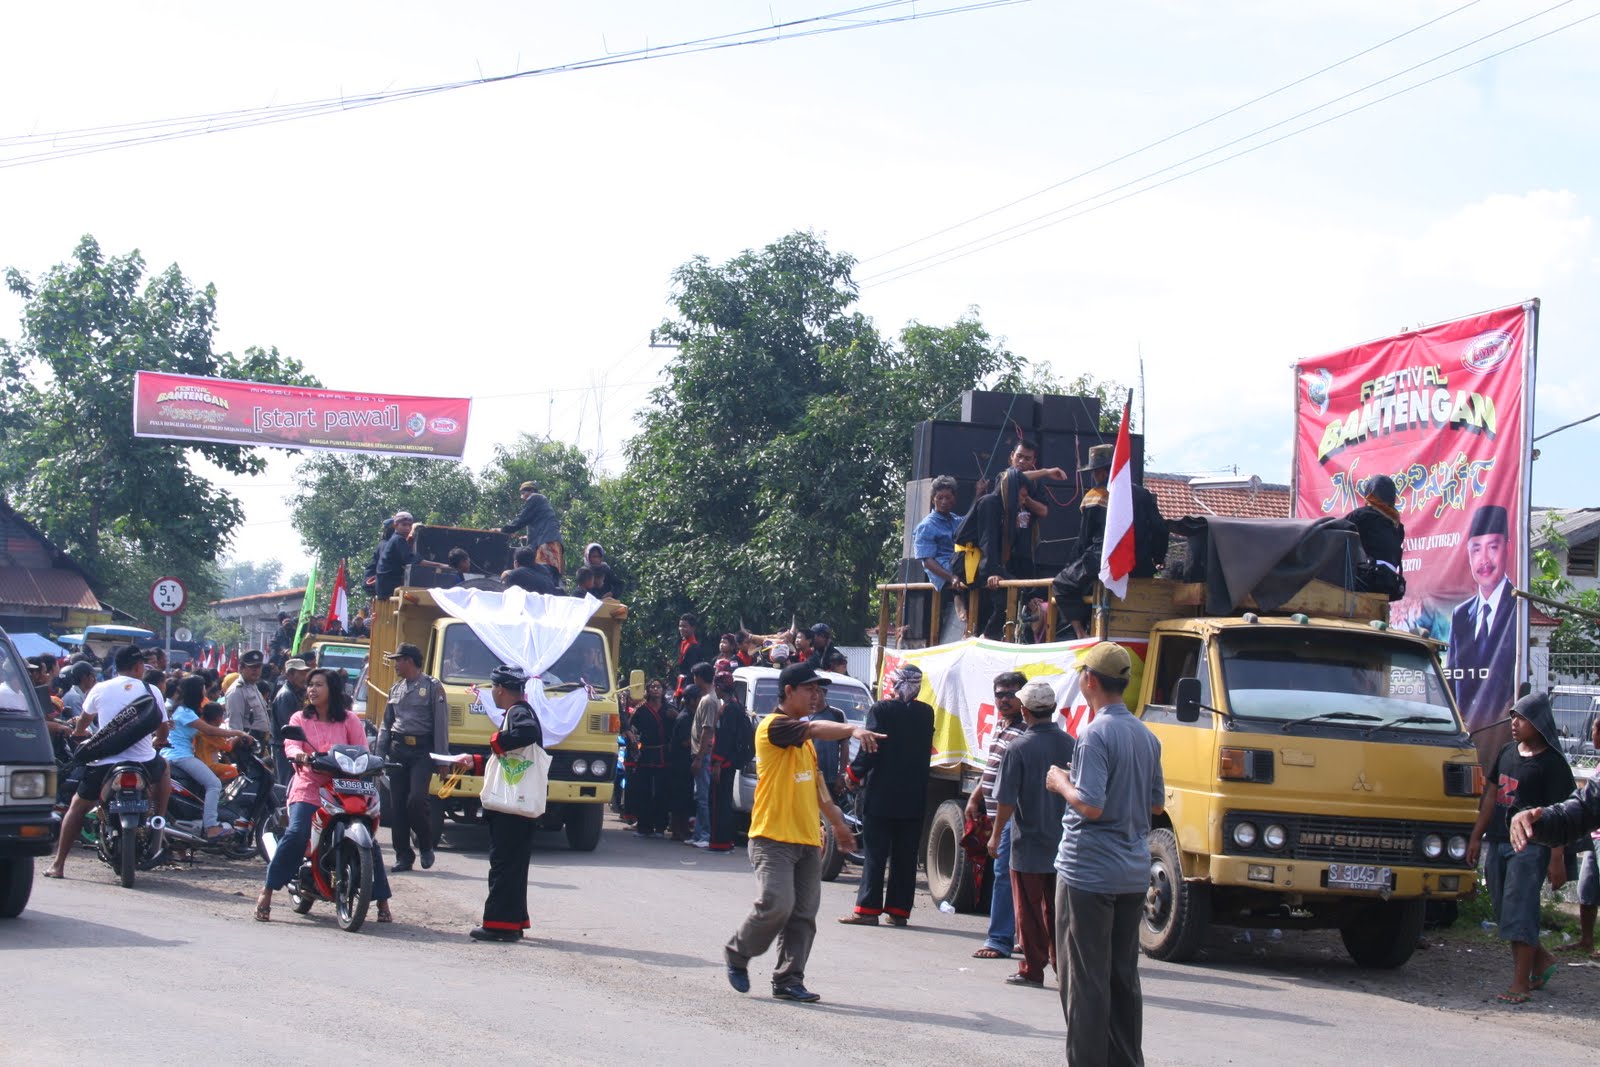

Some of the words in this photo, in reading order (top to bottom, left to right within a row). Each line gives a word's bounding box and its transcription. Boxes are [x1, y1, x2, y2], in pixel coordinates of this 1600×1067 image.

[156, 391, 230, 410] BANTENGAN
[253, 406, 317, 434] [start
[324, 404, 400, 433] pawai]
[1317, 388, 1497, 462] BANTENGAN
[1426, 532, 1460, 550] JATIREJO
[1443, 668, 1490, 680] 2010
[116, 706, 138, 724] SPEED
[1299, 832, 1414, 849] MITSUBISHI
[1329, 864, 1338, 880] S
[1343, 865, 1375, 882] 9045
[1382, 867, 1391, 883] P
